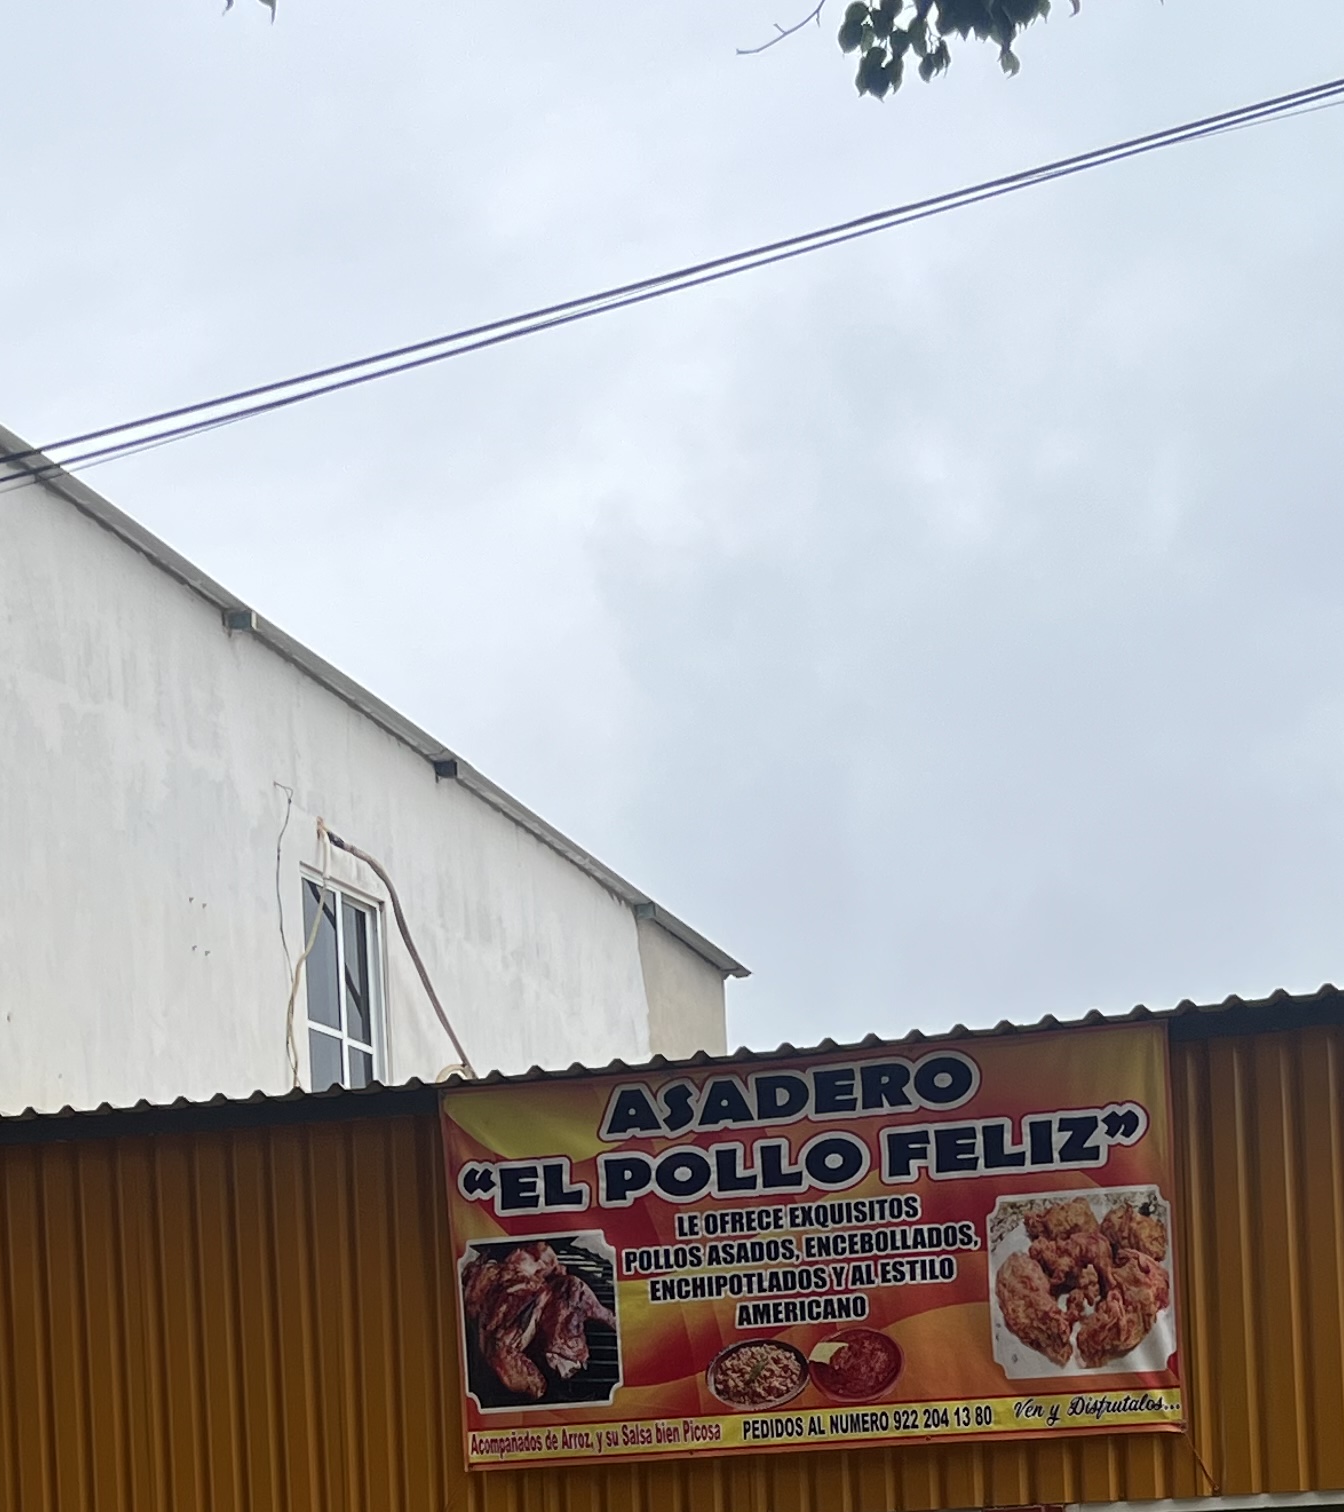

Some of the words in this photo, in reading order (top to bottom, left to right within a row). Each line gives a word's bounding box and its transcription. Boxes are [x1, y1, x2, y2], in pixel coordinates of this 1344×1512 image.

[604, 1052, 977, 1137] ASADERO
[603, 1138, 866, 1202] POLLO
[676, 1214, 699, 1238] LE
[706, 1209, 783, 1236] OFRECE
[789, 1196, 919, 1229] EXQUISITOS
[624, 1245, 703, 1273] POLLOS
[707, 1238, 801, 1267] ASADOS,
[805, 1223, 979, 1258] ENCEBOLLADOS,
[649, 1267, 828, 1302] ENCHIPOTLADOS
[830, 1264, 846, 1288] Y
[850, 1262, 877, 1286] AL
[880, 1257, 955, 1283] ESTILO
[736, 1296, 868, 1327] AMERICANO
[742, 1416, 804, 1440] PEDIDOS
[807, 1416, 826, 1436] AL
[829, 1411, 889, 1435] NUMERO
[893, 1409, 919, 1430] 922
[922, 1407, 950, 1429] 204
[954, 1406, 971, 1427] 13
[975, 1405, 993, 1426] 80
[1013, 1398, 1045, 1419] Ven
[1045, 1404, 1061, 1427] y
[470, 1431, 543, 1458] Acompañados
[545, 1430, 559, 1450] de
[596, 1434, 603, 1453] y
[606, 1432, 619, 1448] su
[621, 1423, 652, 1445] Salsa
[655, 1422, 680, 1444] bien
[682, 1419, 722, 1442] Picosa
